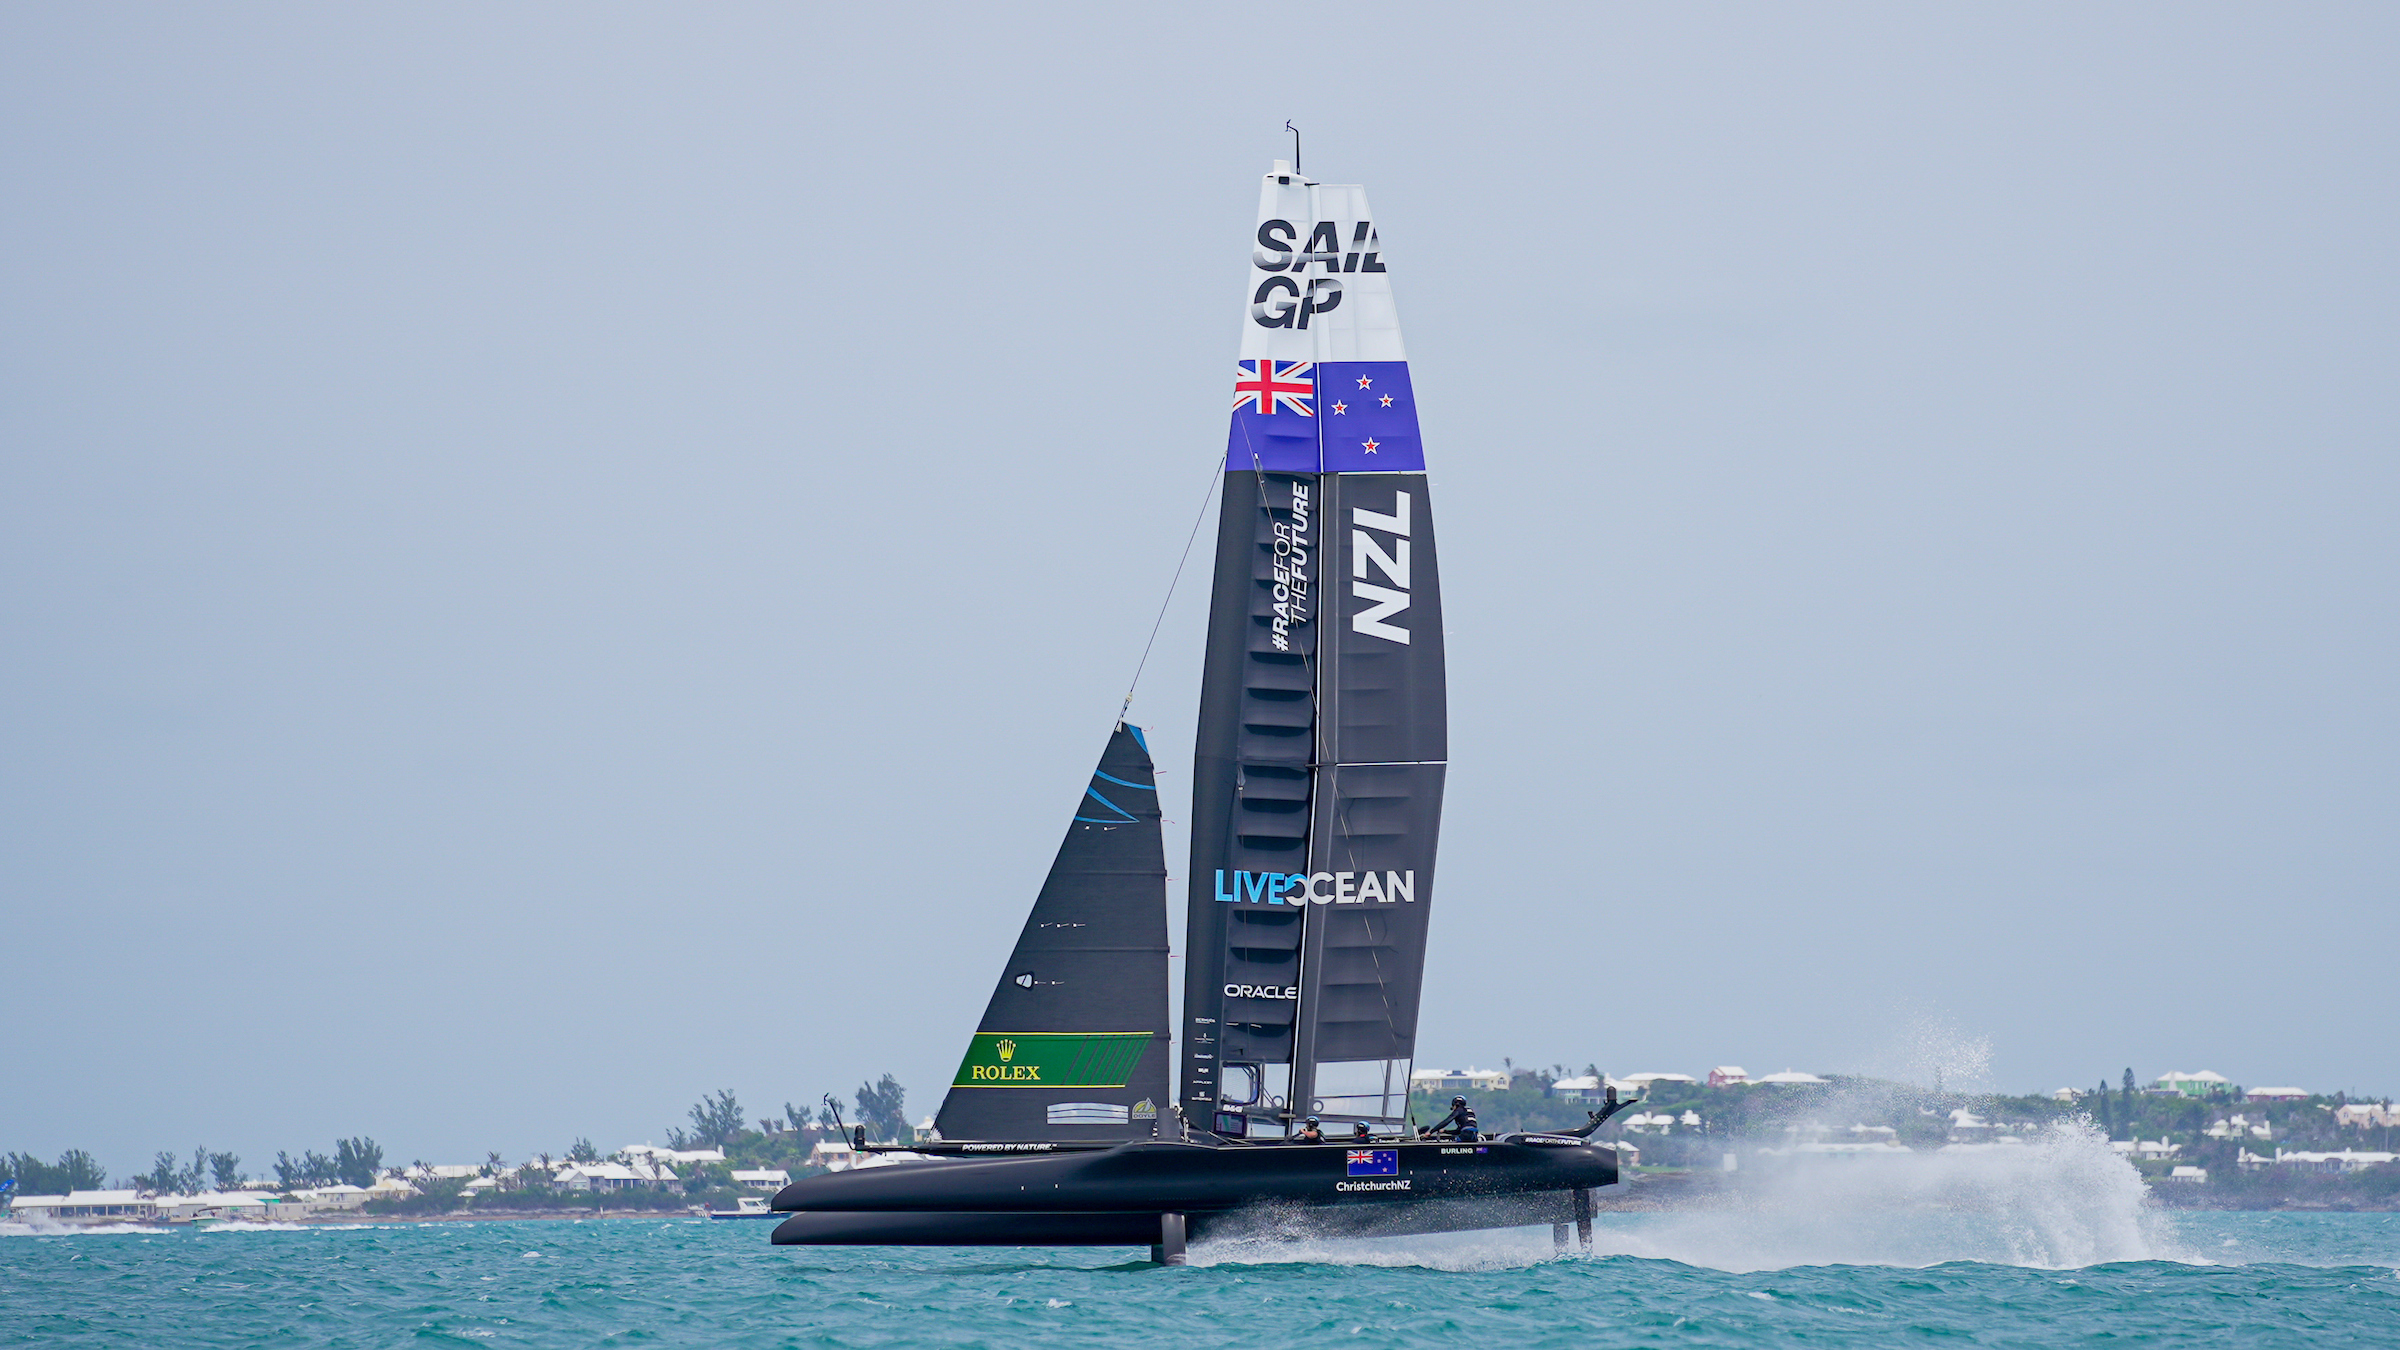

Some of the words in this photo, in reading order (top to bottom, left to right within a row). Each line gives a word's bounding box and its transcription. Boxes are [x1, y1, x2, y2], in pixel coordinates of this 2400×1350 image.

[1251, 276, 1345, 330] GP
[1289, 481, 1309, 623] THEFUTURE
[1352, 490, 1411, 646] NZL
[1271, 521, 1290, 652] #RACEFOR
[1224, 984, 1297, 999] ORACLE
[971, 1065, 1041, 1080] ROLEX
[1222, 1104, 1243, 1113] B&G
[962, 1143, 1004, 1152] POWERED
[1004, 1143, 1016, 1151] BY
[1336, 1180, 1411, 1192] ChristchurchNZ
